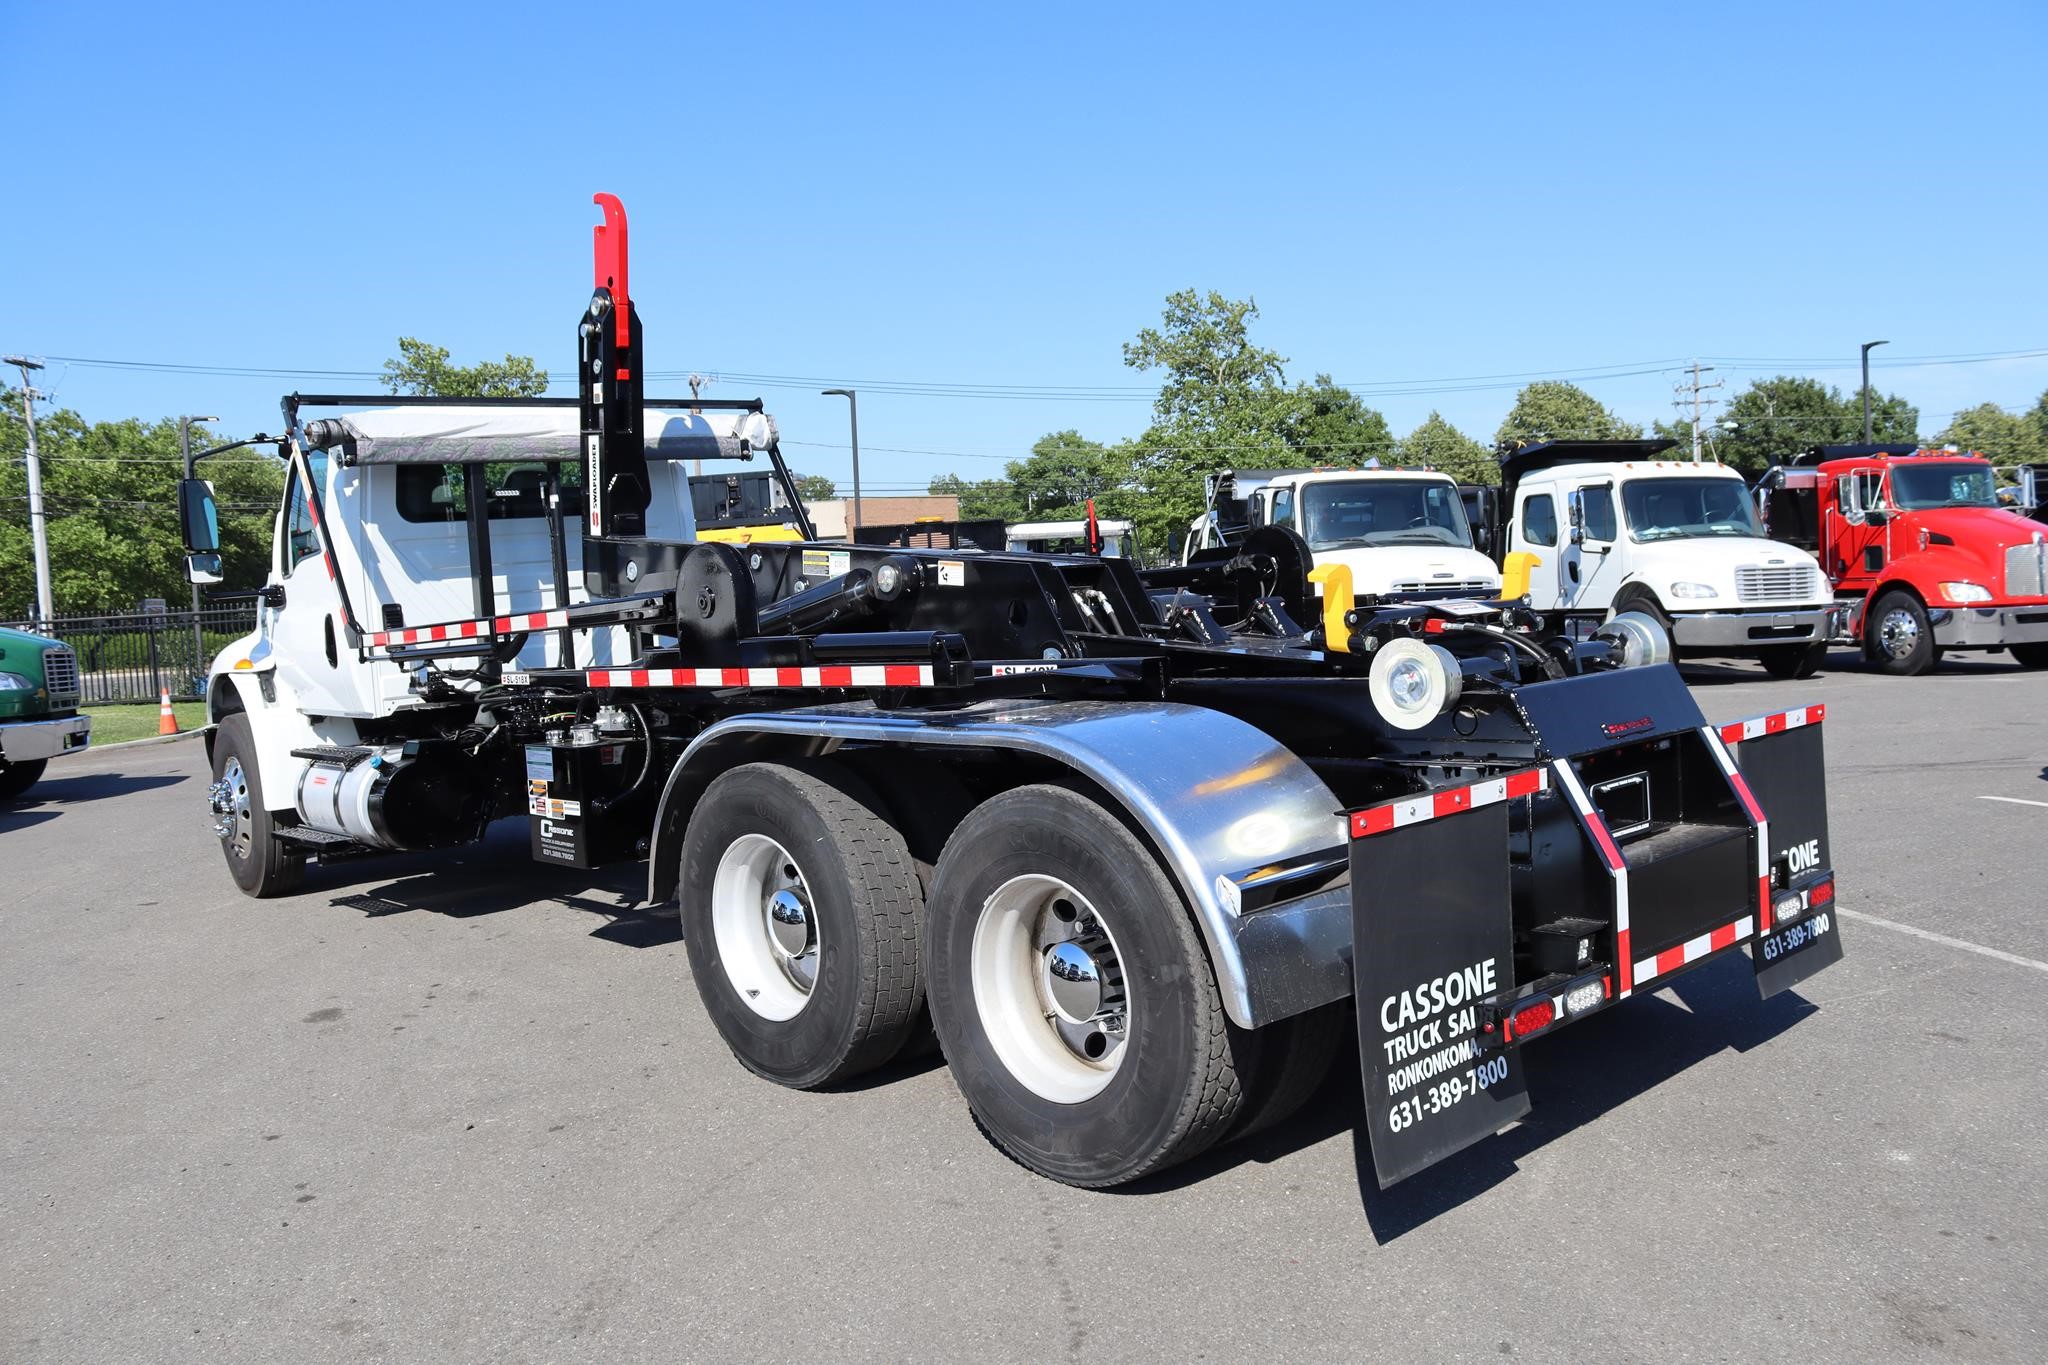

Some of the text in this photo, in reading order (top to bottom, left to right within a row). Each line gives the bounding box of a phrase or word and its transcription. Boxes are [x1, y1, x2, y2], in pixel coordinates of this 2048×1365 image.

[1763, 913, 1829, 960] 631-389-7800
[1380, 957, 1497, 1033] CASSONE
[1383, 1019, 1443, 1066] TRUCK
[1389, 1055, 1508, 1133] 631-389-7800
